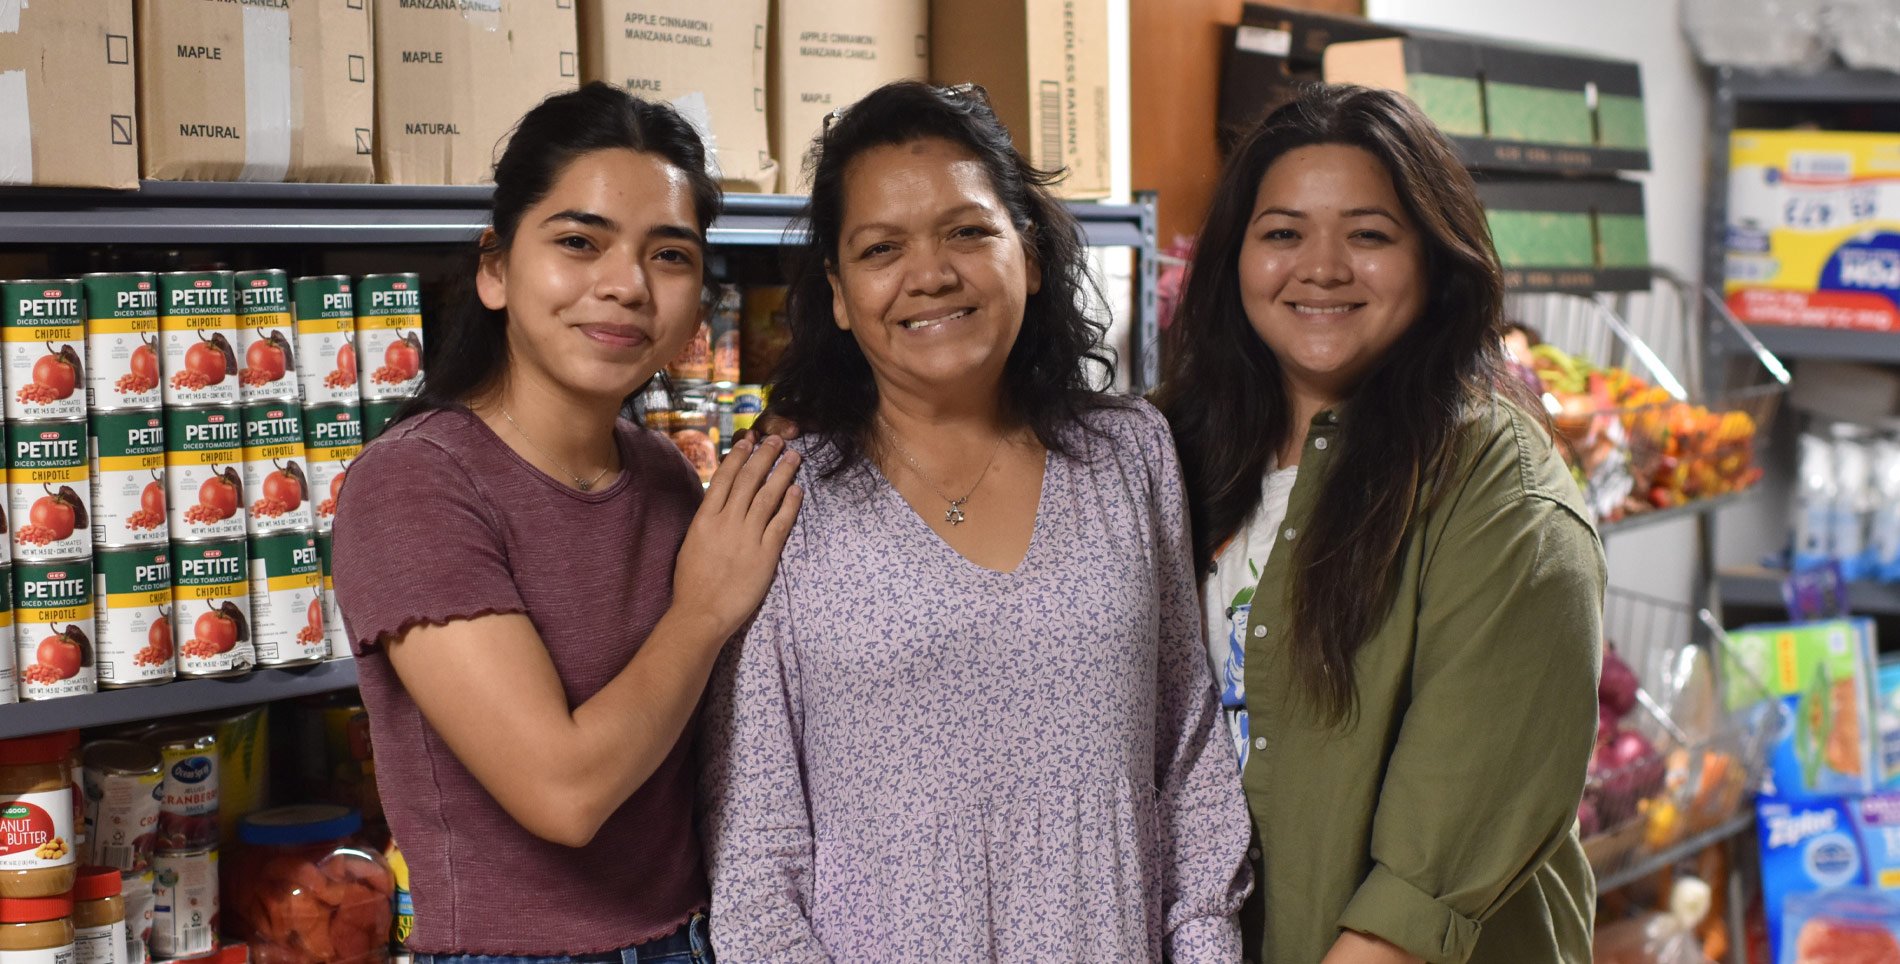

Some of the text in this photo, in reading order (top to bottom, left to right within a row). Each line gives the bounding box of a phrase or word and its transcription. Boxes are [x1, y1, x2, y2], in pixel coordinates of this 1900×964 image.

[624, 13, 656, 26] APPLE
[659, 16, 707, 31] CINNAMON
[625, 28, 712, 47] MANZANA CANELA
[800, 31, 872, 44] APPLE CINNAMON
[177, 45, 221, 60] MAPLE
[402, 51, 443, 63] MAPLE
[800, 47, 876, 60] MANZANA CANELA
[627, 78, 661, 91] MAPLE
[1065, 0, 1077, 155] SEEDLESS RAISINS
[800, 93, 831, 104] MAPLE
[180, 124, 240, 139] NATURAL
[405, 123, 460, 135] NATURAL
[117, 291, 157, 308] PETIT
[172, 289, 228, 306] PETITE
[372, 291, 418, 307] PETITE
[20, 299, 77, 317] PETITE
[186, 317, 221, 327] CHIPOTLE
[245, 315, 279, 326] CHIPOTLE
[385, 317, 415, 327] CHIPOTLE
[35, 329, 71, 339] CHIPOTLE
[186, 423, 238, 441] PETITE
[246, 418, 298, 437] PETITE
[316, 421, 360, 438] PETITE
[129, 428, 163, 446] PETIT
[17, 440, 77, 458] PETITE
[201, 451, 233, 462] CHIPOTLE
[262, 446, 294, 457] CHIPOTLE
[32, 470, 70, 480] CHIPOTLE
[136, 563, 170, 582] PETIT
[182, 557, 238, 576] PETITE
[24, 579, 84, 598] PETITE
[196, 586, 232, 597] CHIPOTLE
[39, 609, 76, 620] CHIPOTLE
[0, 819, 31, 832] ANUT
[8, 830, 47, 845] BUTTER
